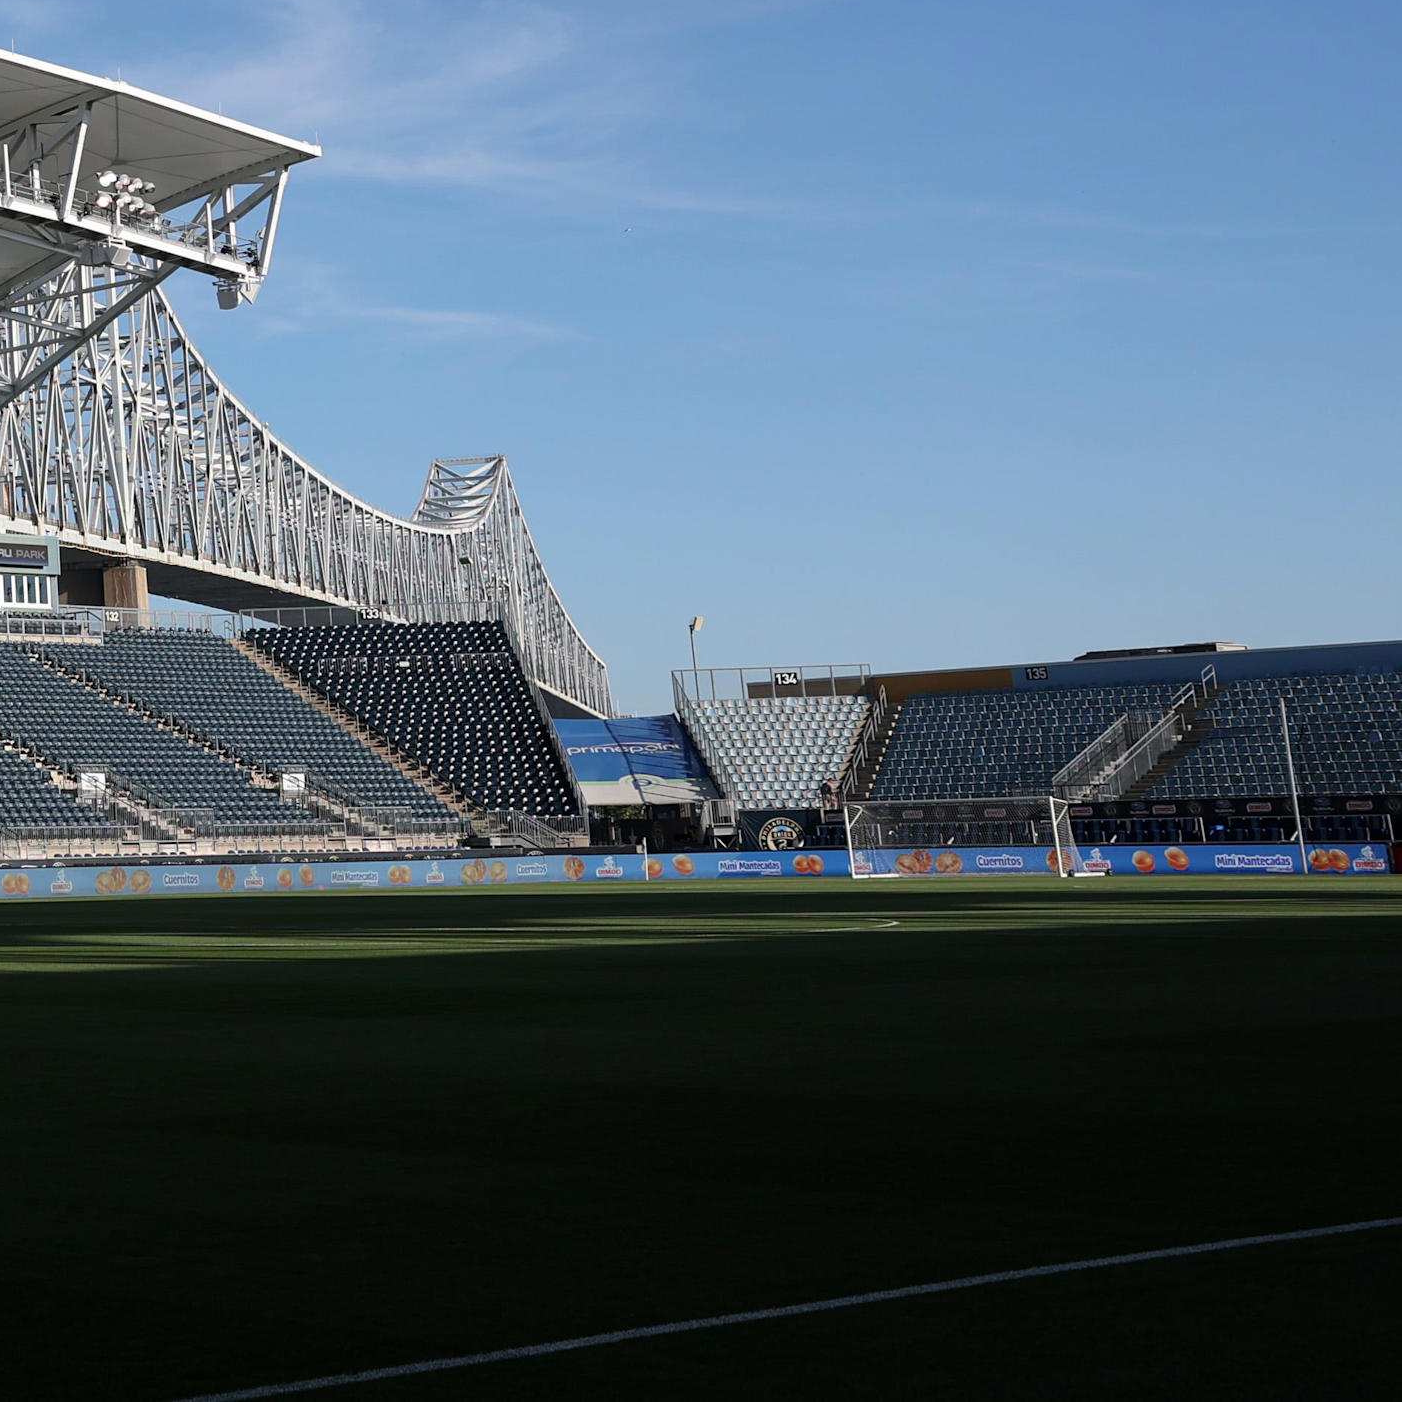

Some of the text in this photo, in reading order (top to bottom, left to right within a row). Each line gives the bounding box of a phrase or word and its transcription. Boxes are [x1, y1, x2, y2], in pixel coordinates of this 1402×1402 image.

[16, 549, 46, 560] PARK
[105, 611, 119, 623] 132
[360, 608, 379, 620] 133
[775, 672, 797, 685] 134
[1025, 667, 1047, 680] 135
[720, 860, 780, 870] Mini Mantecadas
[978, 855, 1022, 867] Cuernitos
[1216, 855, 1291, 867] Mini Mantecadas
[163, 873, 198, 885] Cuernitos
